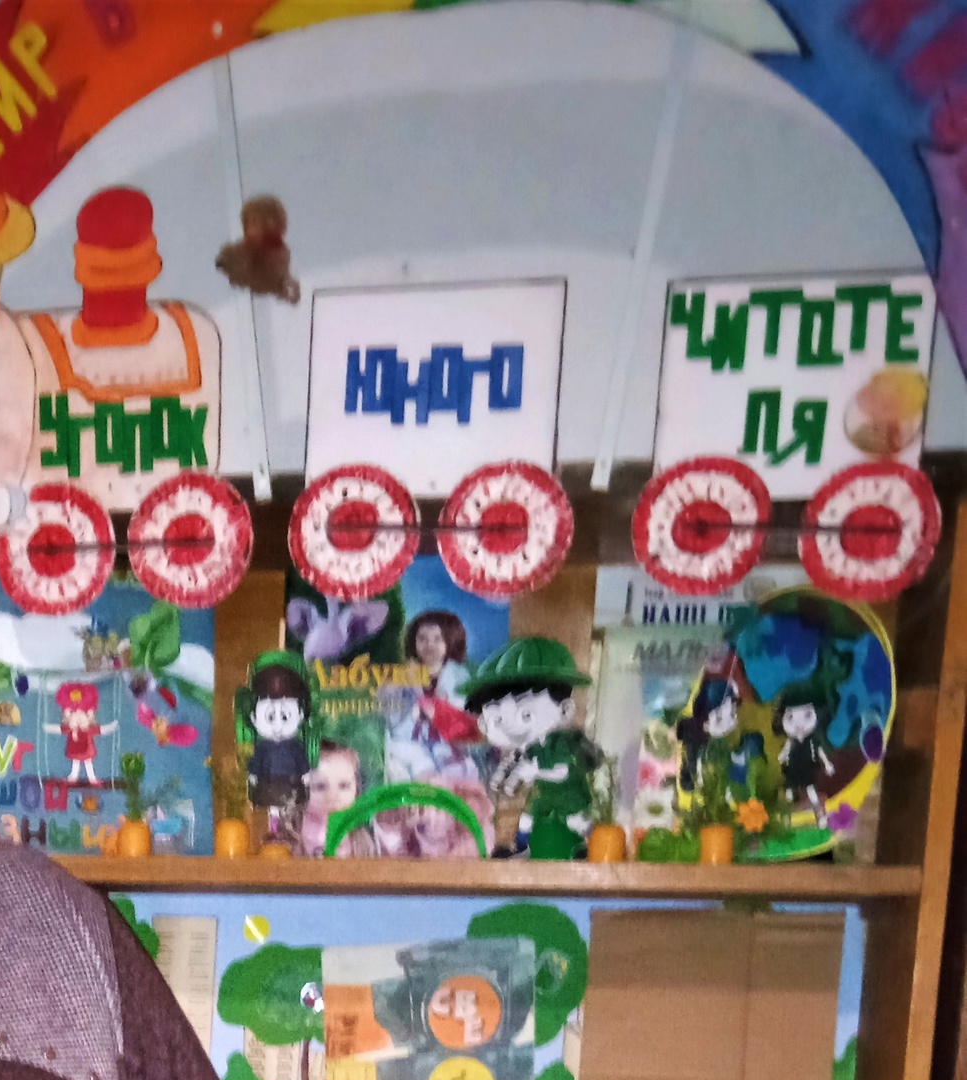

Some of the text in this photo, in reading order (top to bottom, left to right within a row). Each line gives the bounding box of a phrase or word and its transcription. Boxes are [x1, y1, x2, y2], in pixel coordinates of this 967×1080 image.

[670, 284, 924, 370] ЧИТАТЕ
[343, 345, 523, 425] ЮНОГО
[38, 391, 209, 478] УГОЛОК
